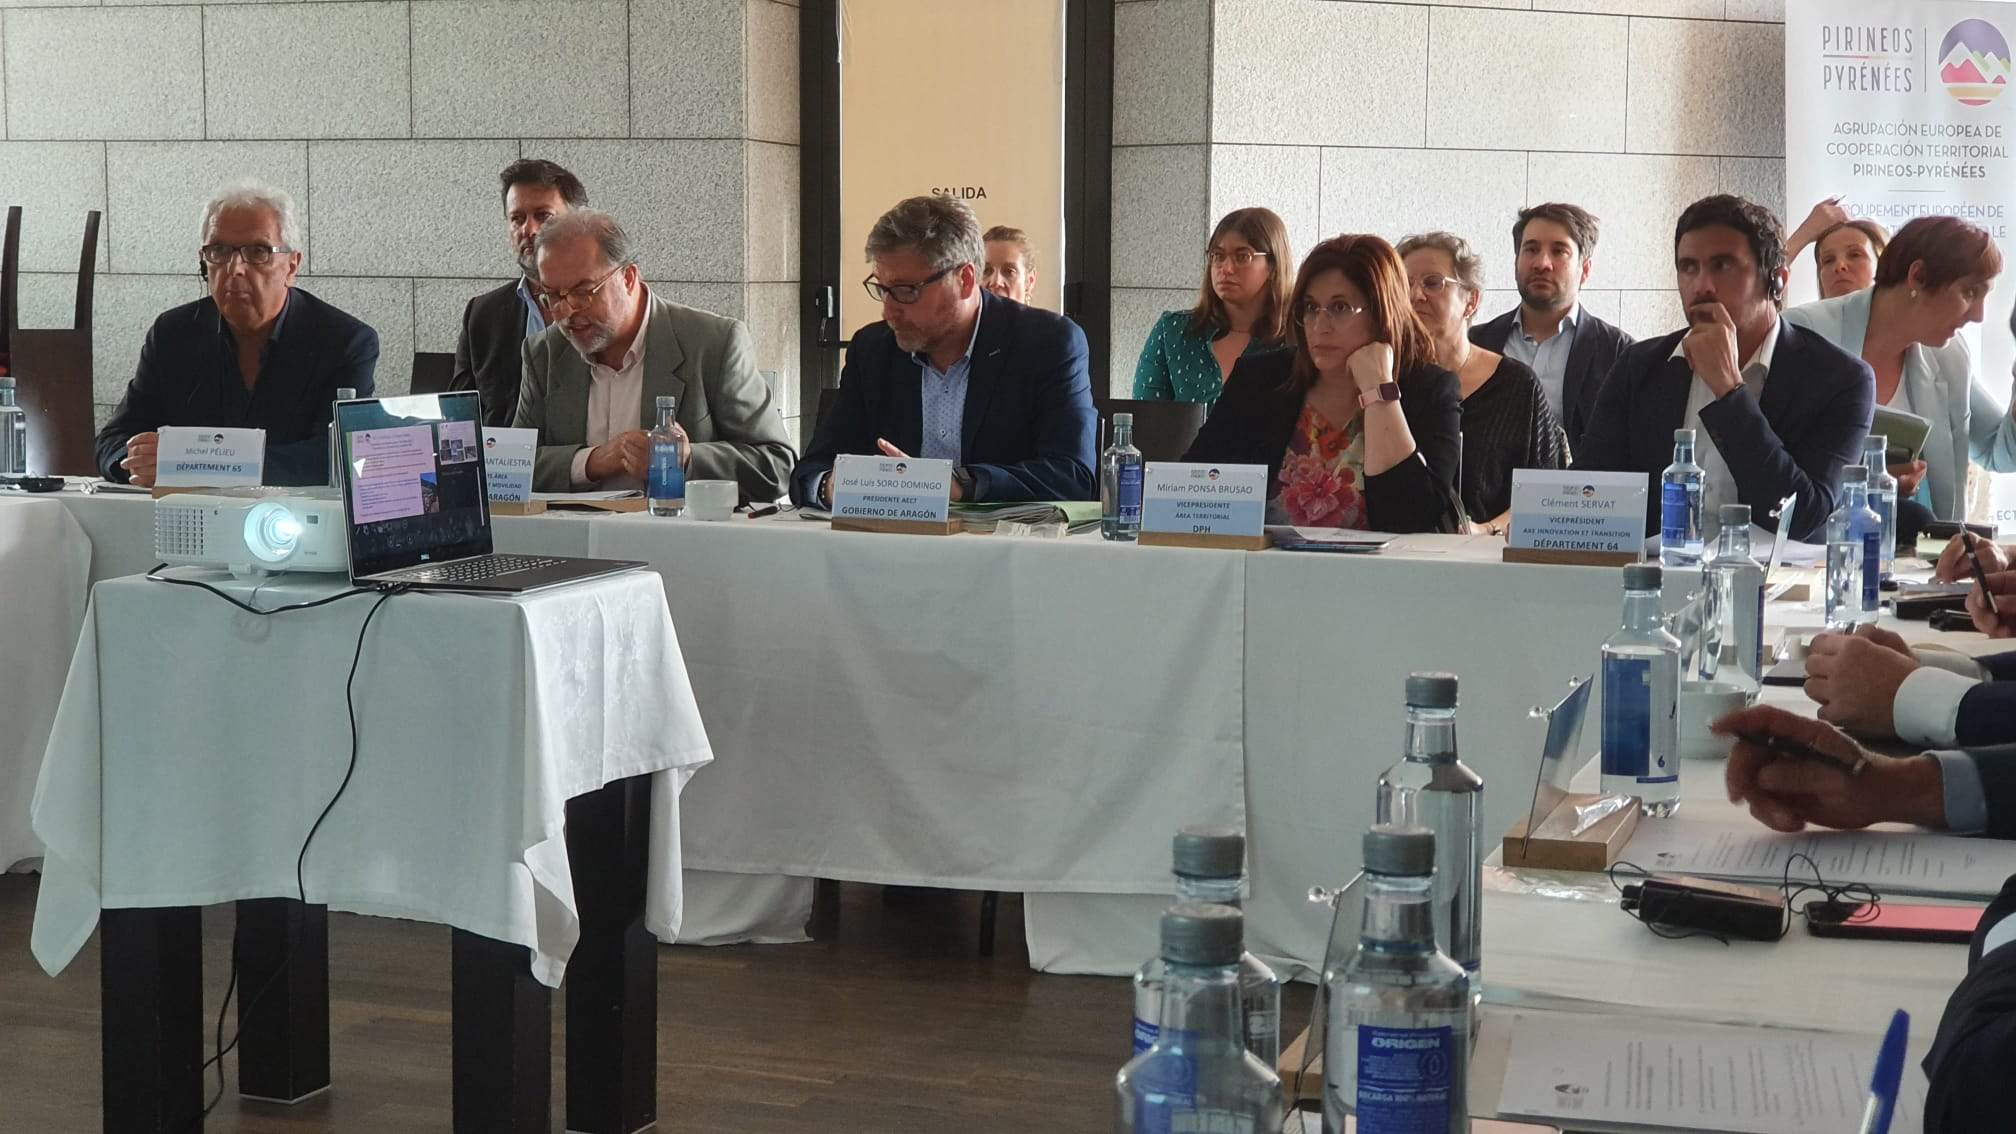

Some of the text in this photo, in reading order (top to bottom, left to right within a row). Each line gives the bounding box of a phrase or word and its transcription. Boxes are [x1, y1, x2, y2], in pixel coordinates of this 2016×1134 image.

[1822, 25, 1913, 54] PIRINEOS
[1823, 62, 1912, 93] PYRÉNÉES
[1833, 120, 2002, 138] AGRUPACIÓN EUROPEA DE
[1826, 141, 2009, 159] COOPERACIÓN TERRITORIAL
[1853, 162, 1986, 178] PIRINEOS-PYRÉNÉES
[1844, 203, 1917, 217] OUPEMENT
[1987, 205, 2004, 217] DE
[176, 462, 231, 472] DÉPARTEMENT
[876, 479, 899, 488] SORO
[901, 481, 941, 490] DOMINGO
[1157, 483, 1185, 492] Miriam
[1188, 485, 1216, 493] PONSA
[1541, 498, 1616, 509] Clément SERVAT
[842, 507, 937, 519] GOBIERNO DE ARAGÓN
[1550, 516, 1606, 525] VICEPRÉSIDENT
[1193, 525, 1211, 533] DPH
[1533, 539, 1619, 550] DÉPARTEMENT 64
[1371, 1037, 1441, 1049] ORIGEN
